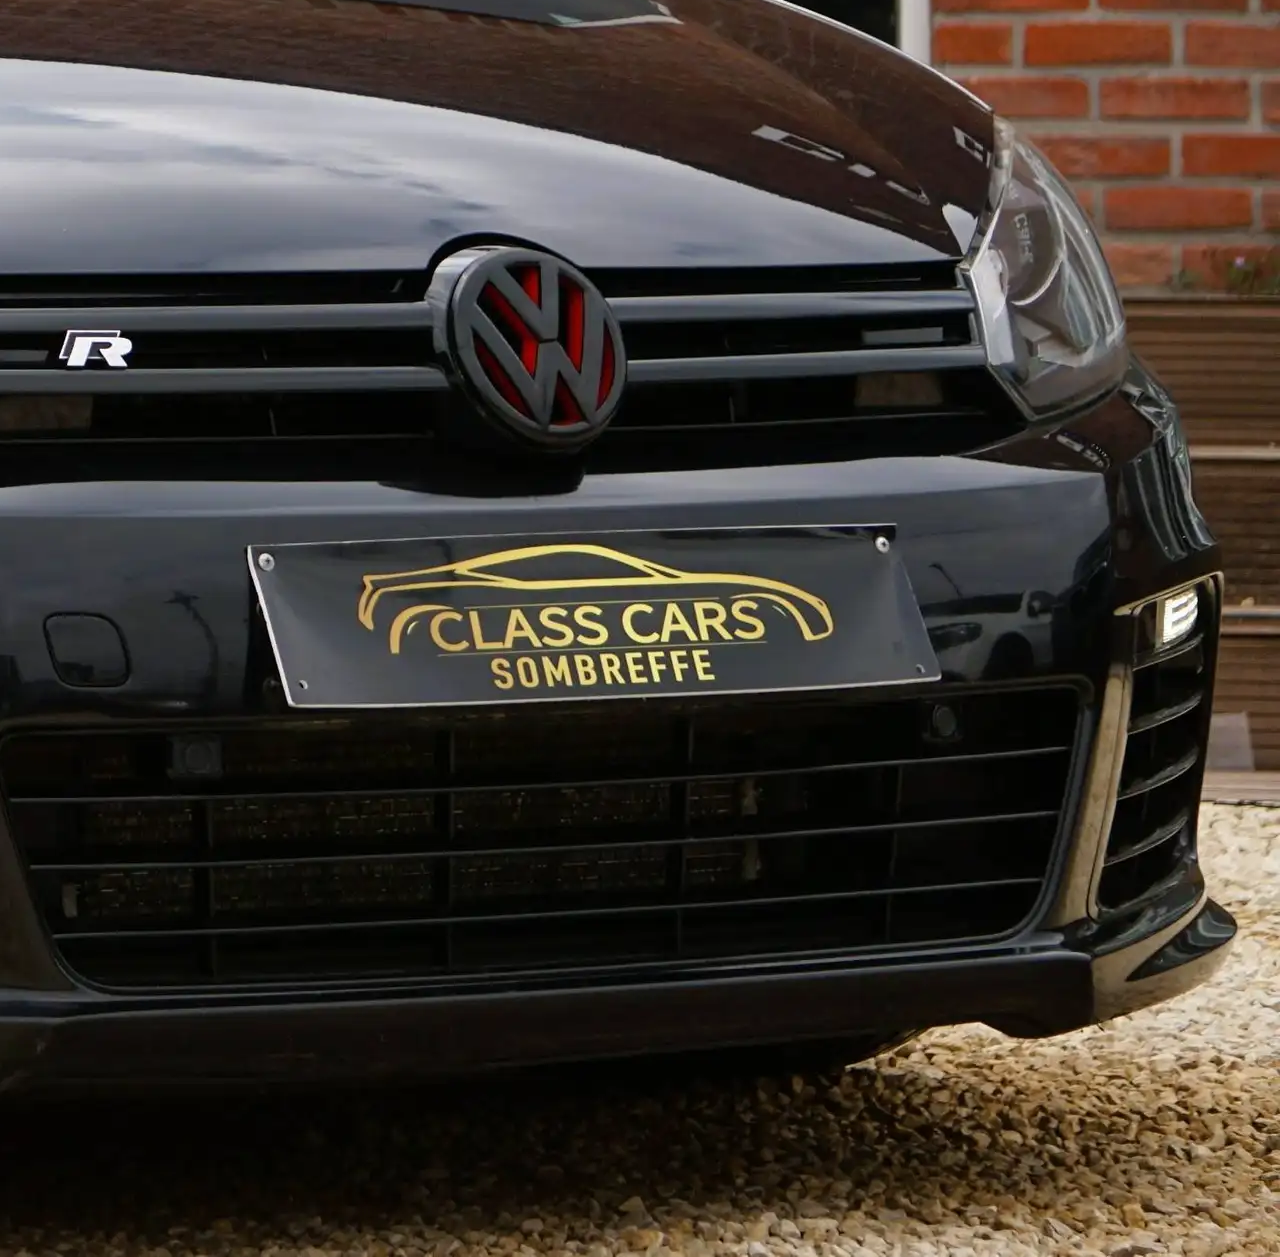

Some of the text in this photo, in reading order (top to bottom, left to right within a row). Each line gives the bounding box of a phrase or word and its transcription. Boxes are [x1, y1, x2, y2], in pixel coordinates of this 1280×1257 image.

[62, 333, 133, 367] R
[430, 599, 767, 652] CLASS CARS
[490, 650, 716, 690] SOMBREFFE
